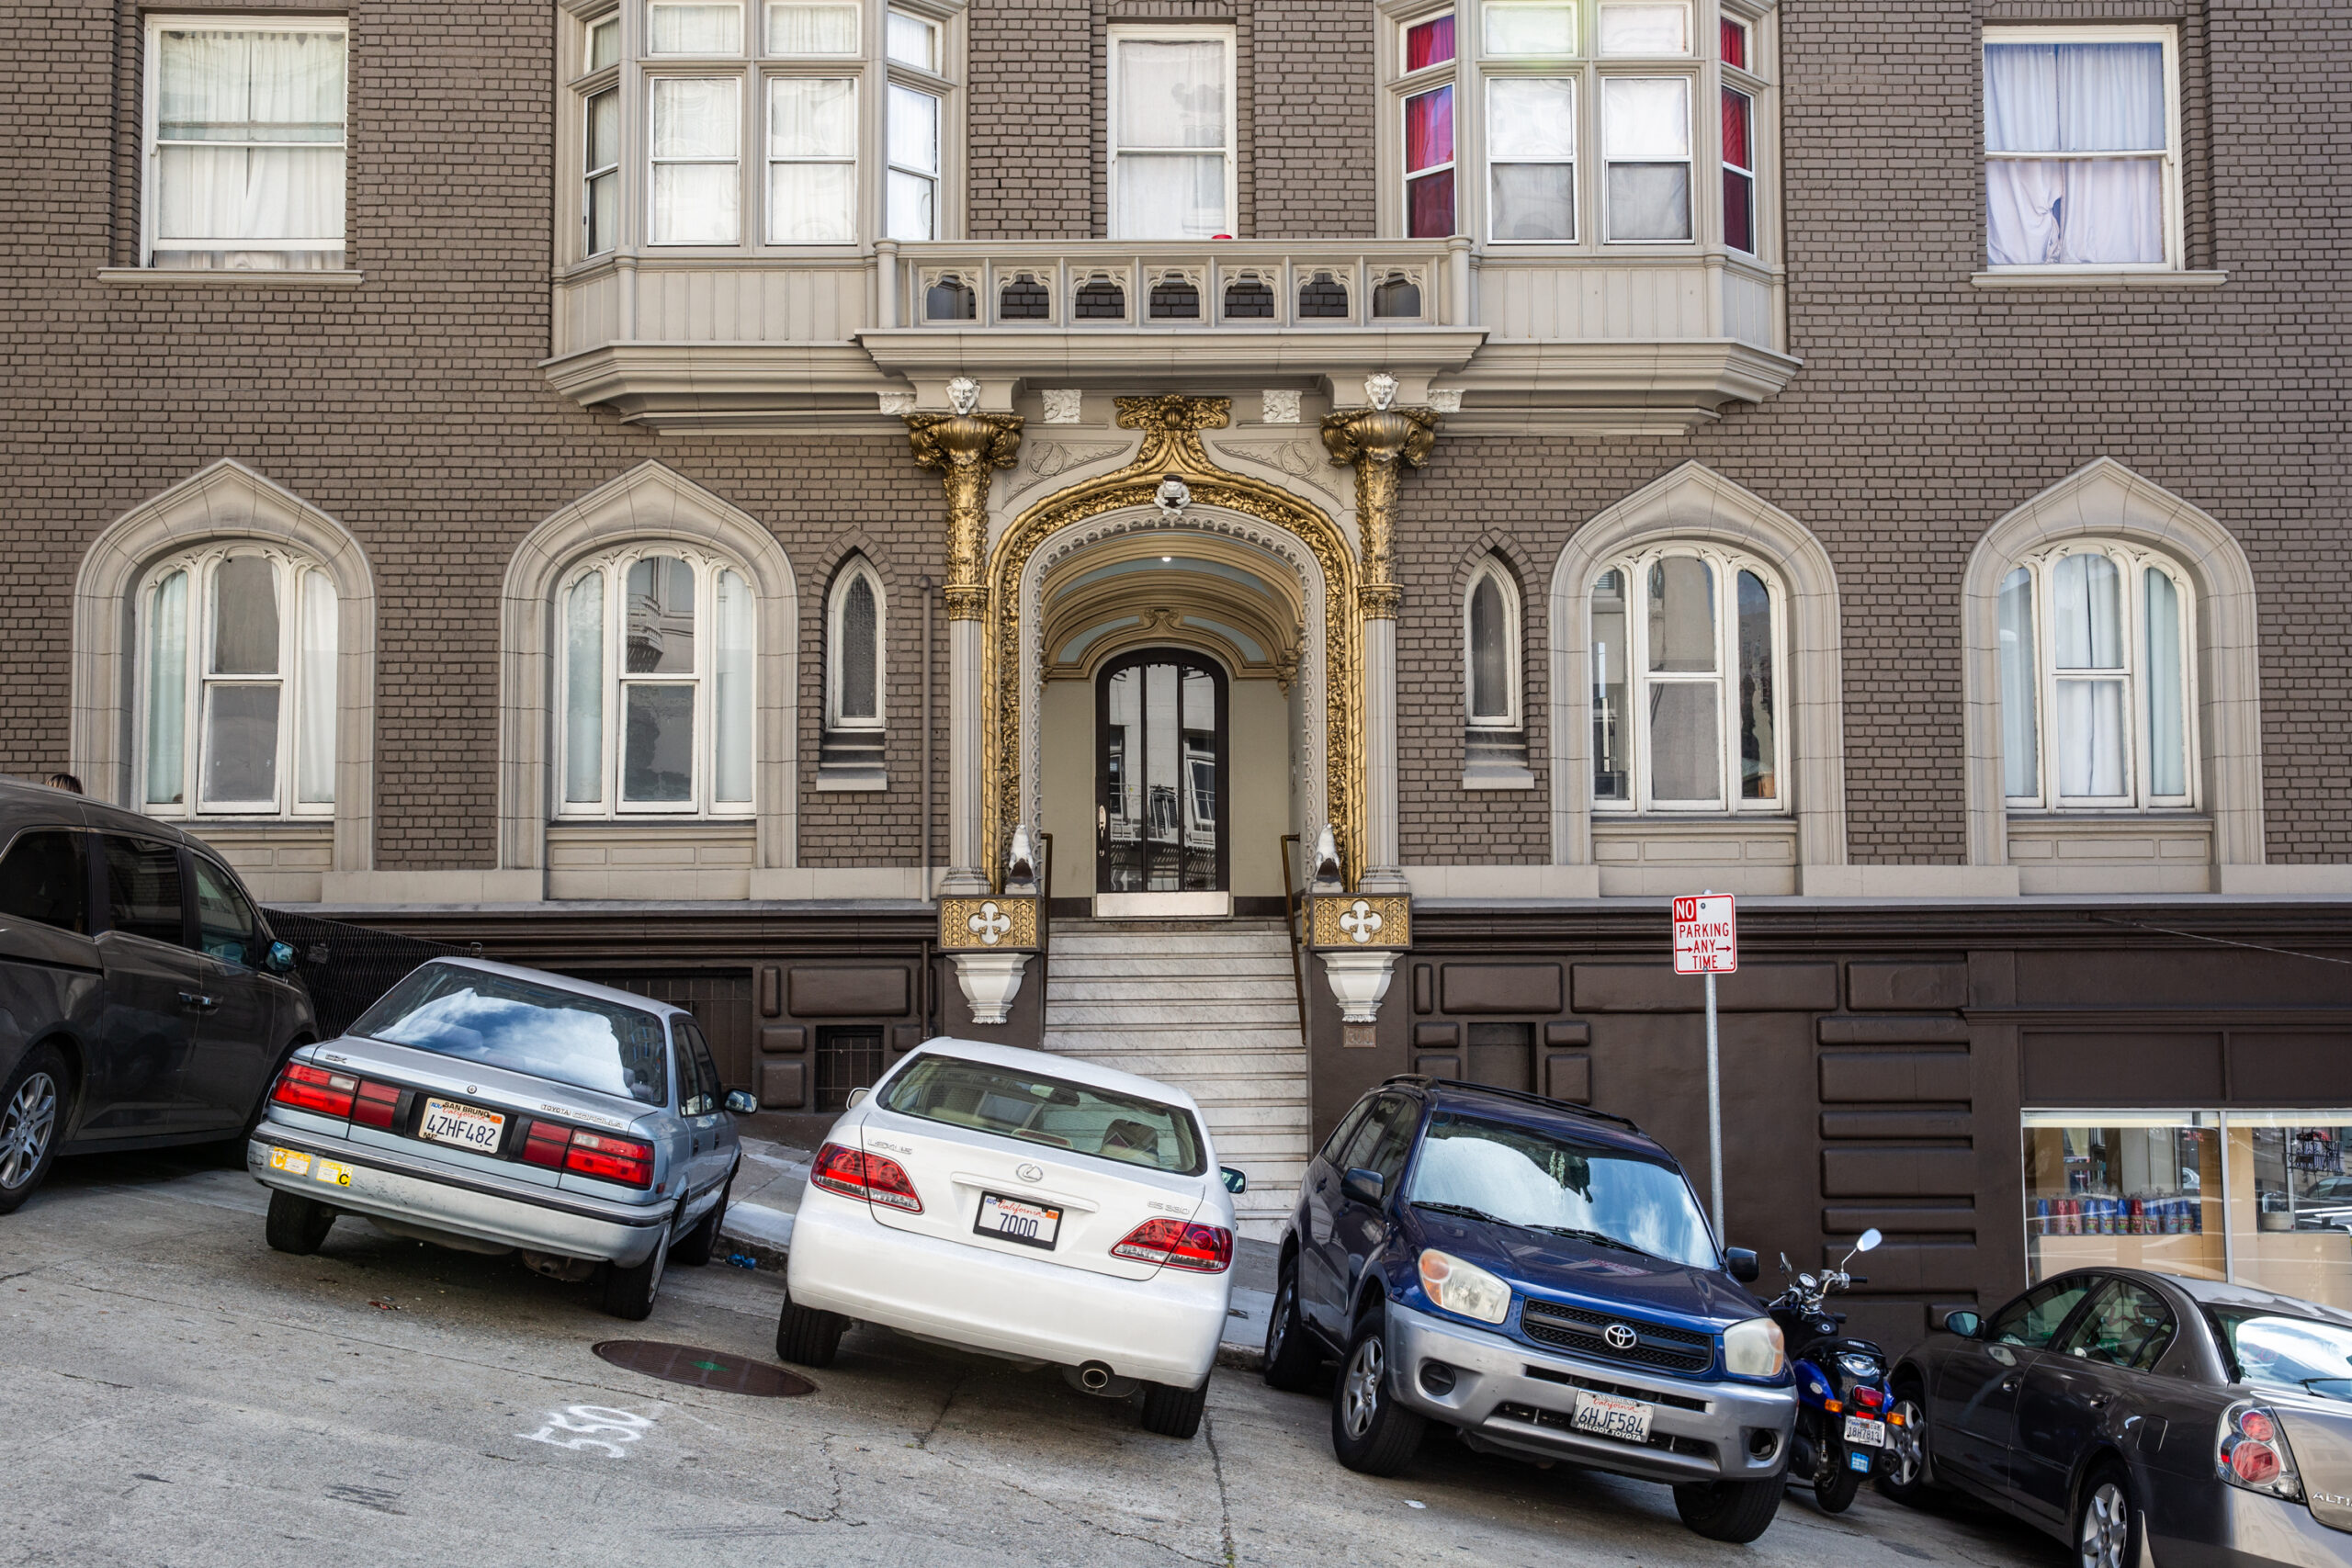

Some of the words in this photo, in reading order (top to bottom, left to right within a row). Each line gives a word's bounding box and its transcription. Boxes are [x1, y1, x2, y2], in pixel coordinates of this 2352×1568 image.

[1676, 899, 1695, 919] NO
[1679, 922, 1729, 938] PARKING
[1693, 939, 1716, 953] ANY
[1692, 955, 1718, 969] TIME
[444, 1102, 461, 1111] SAN
[462, 1107, 491, 1118] BRUNO
[542, 1104, 570, 1115] TOYOTA
[572, 1111, 624, 1129] COROLLA
[426, 1114, 496, 1146] 4ZHF482
[338, 1173, 349, 1185] C
[998, 1199, 1046, 1218] California
[1000, 1213, 1038, 1238] 7000
[1593, 1398, 1639, 1413] California
[1578, 1406, 1644, 1435] 6HJF584
[1577, 1422, 1610, 1434] MELODY
[1611, 1429, 1642, 1441] TOYOTA
[2312, 1491, 2352, 1507] ALTI
